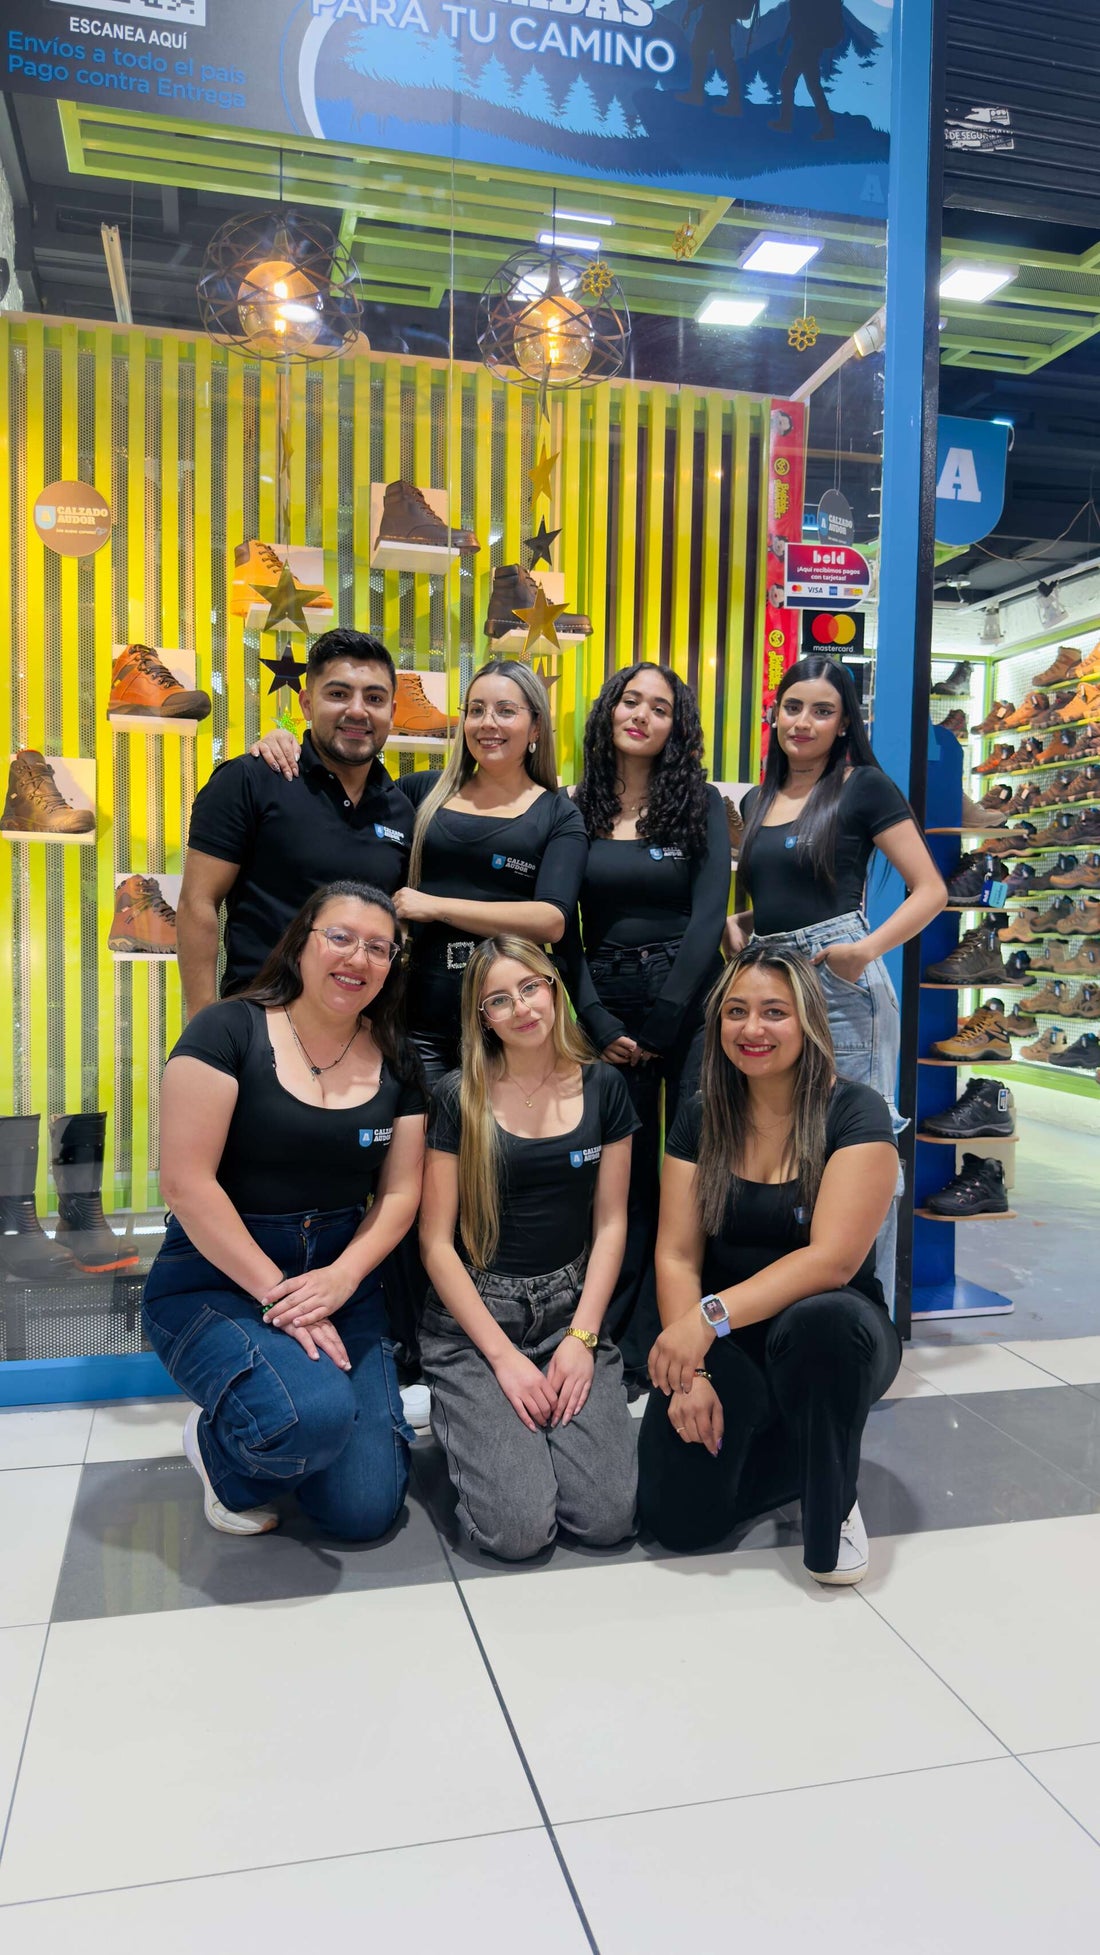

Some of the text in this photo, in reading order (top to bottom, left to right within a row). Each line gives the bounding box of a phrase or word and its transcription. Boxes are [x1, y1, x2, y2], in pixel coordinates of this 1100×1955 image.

[69, 16, 188, 50] ESCANEA AQUÍ
[442, 4, 496, 43] TU
[510, 17, 676, 73] CAMINO
[8, 31, 85, 60] Envíos
[93, 47, 105, 63] a
[113, 47, 168, 73] todo
[174, 58, 193, 77] el
[8, 54, 247, 109] Pago contra Entrega
[936, 447, 982, 503] A
[56, 506, 109, 517] CALZADO
[56, 515, 96, 525] AUDOR
[812, 550, 845, 565] bold
[842, 569, 860, 577] pagos
[808, 586, 823, 594] VISA
[813, 644, 854, 653] mastercard
[505, 862, 529, 873] AUDOR
[506, 857, 536, 870] CALZADO
